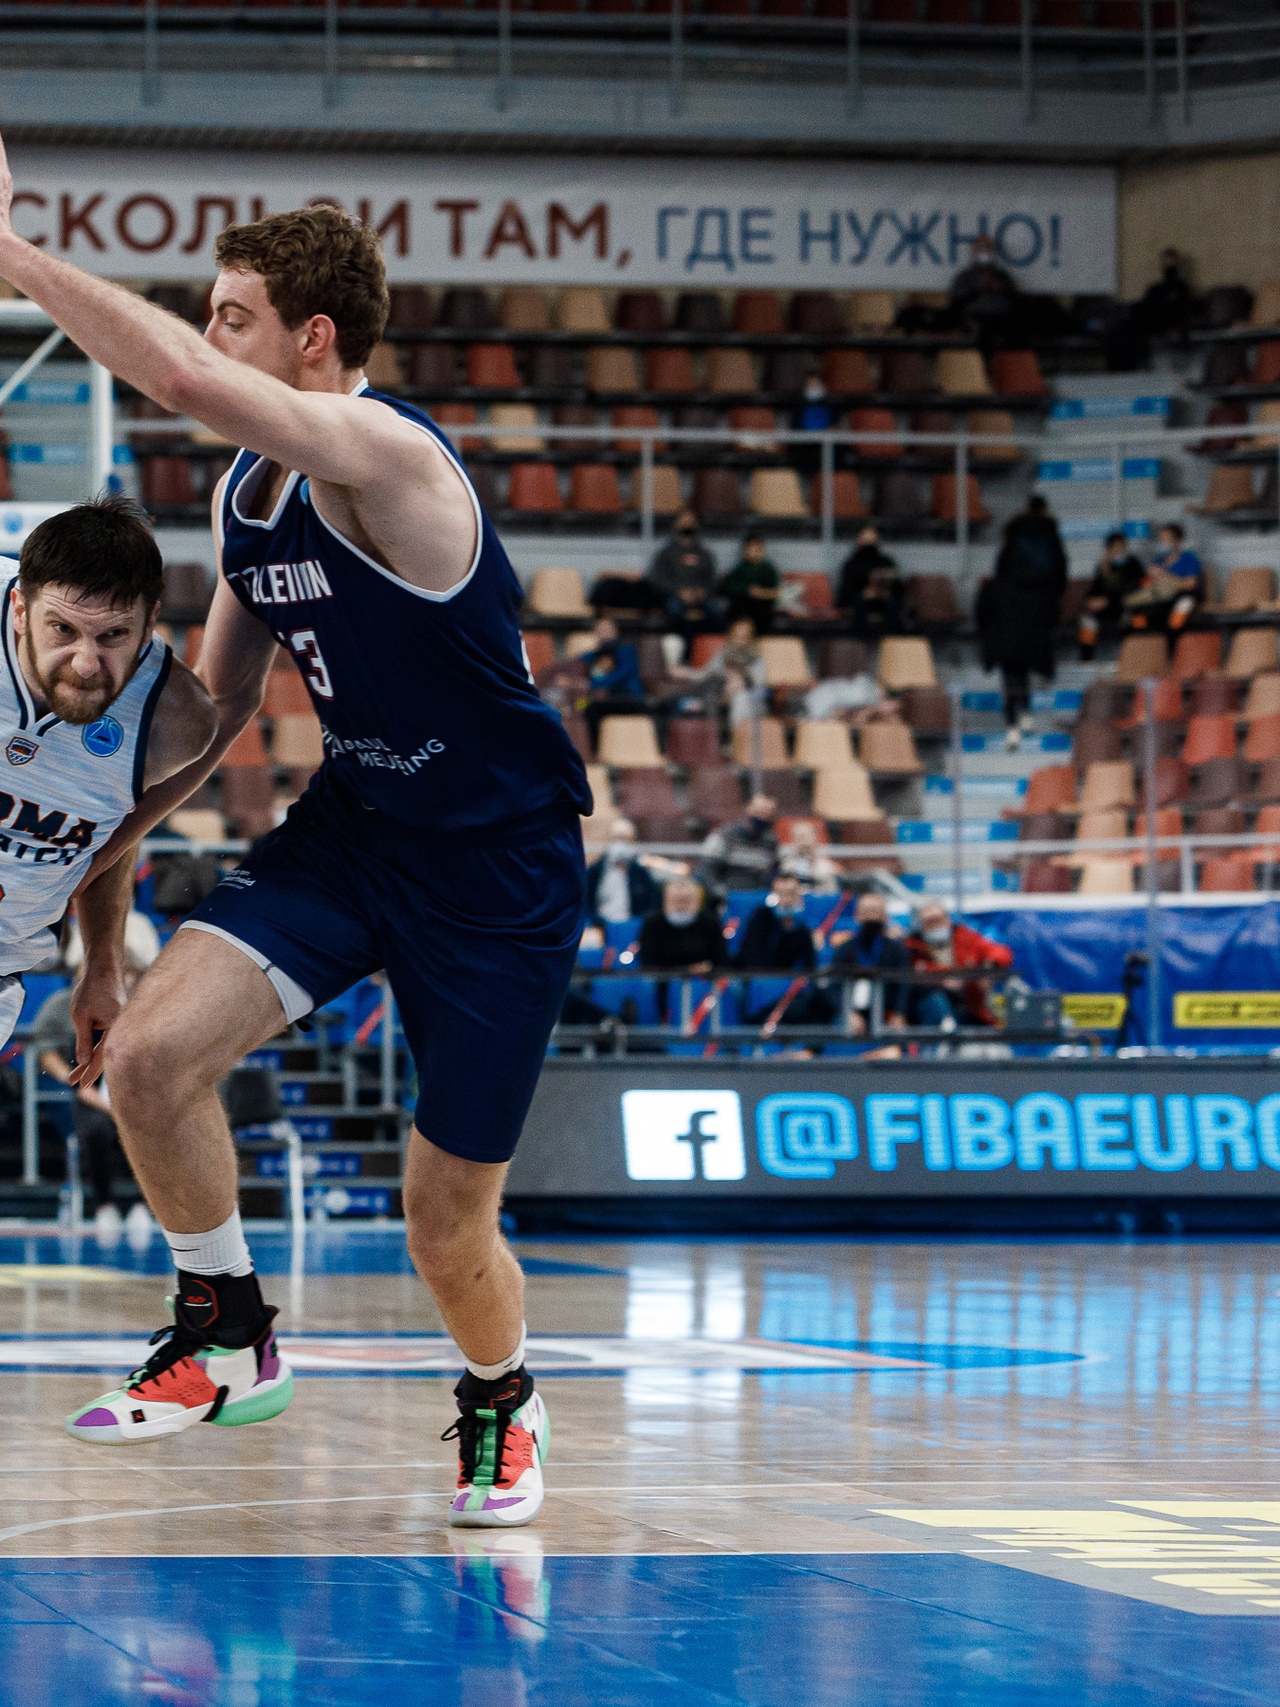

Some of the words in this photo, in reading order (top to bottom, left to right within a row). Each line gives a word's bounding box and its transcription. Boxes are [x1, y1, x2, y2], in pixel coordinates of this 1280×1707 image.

[9, 190, 410, 259] СКОЛИ
[434, 199, 630, 270] ТАМ,
[656, 206, 774, 272] ГДЕ
[799, 210, 1060, 269] НУЖНО!
